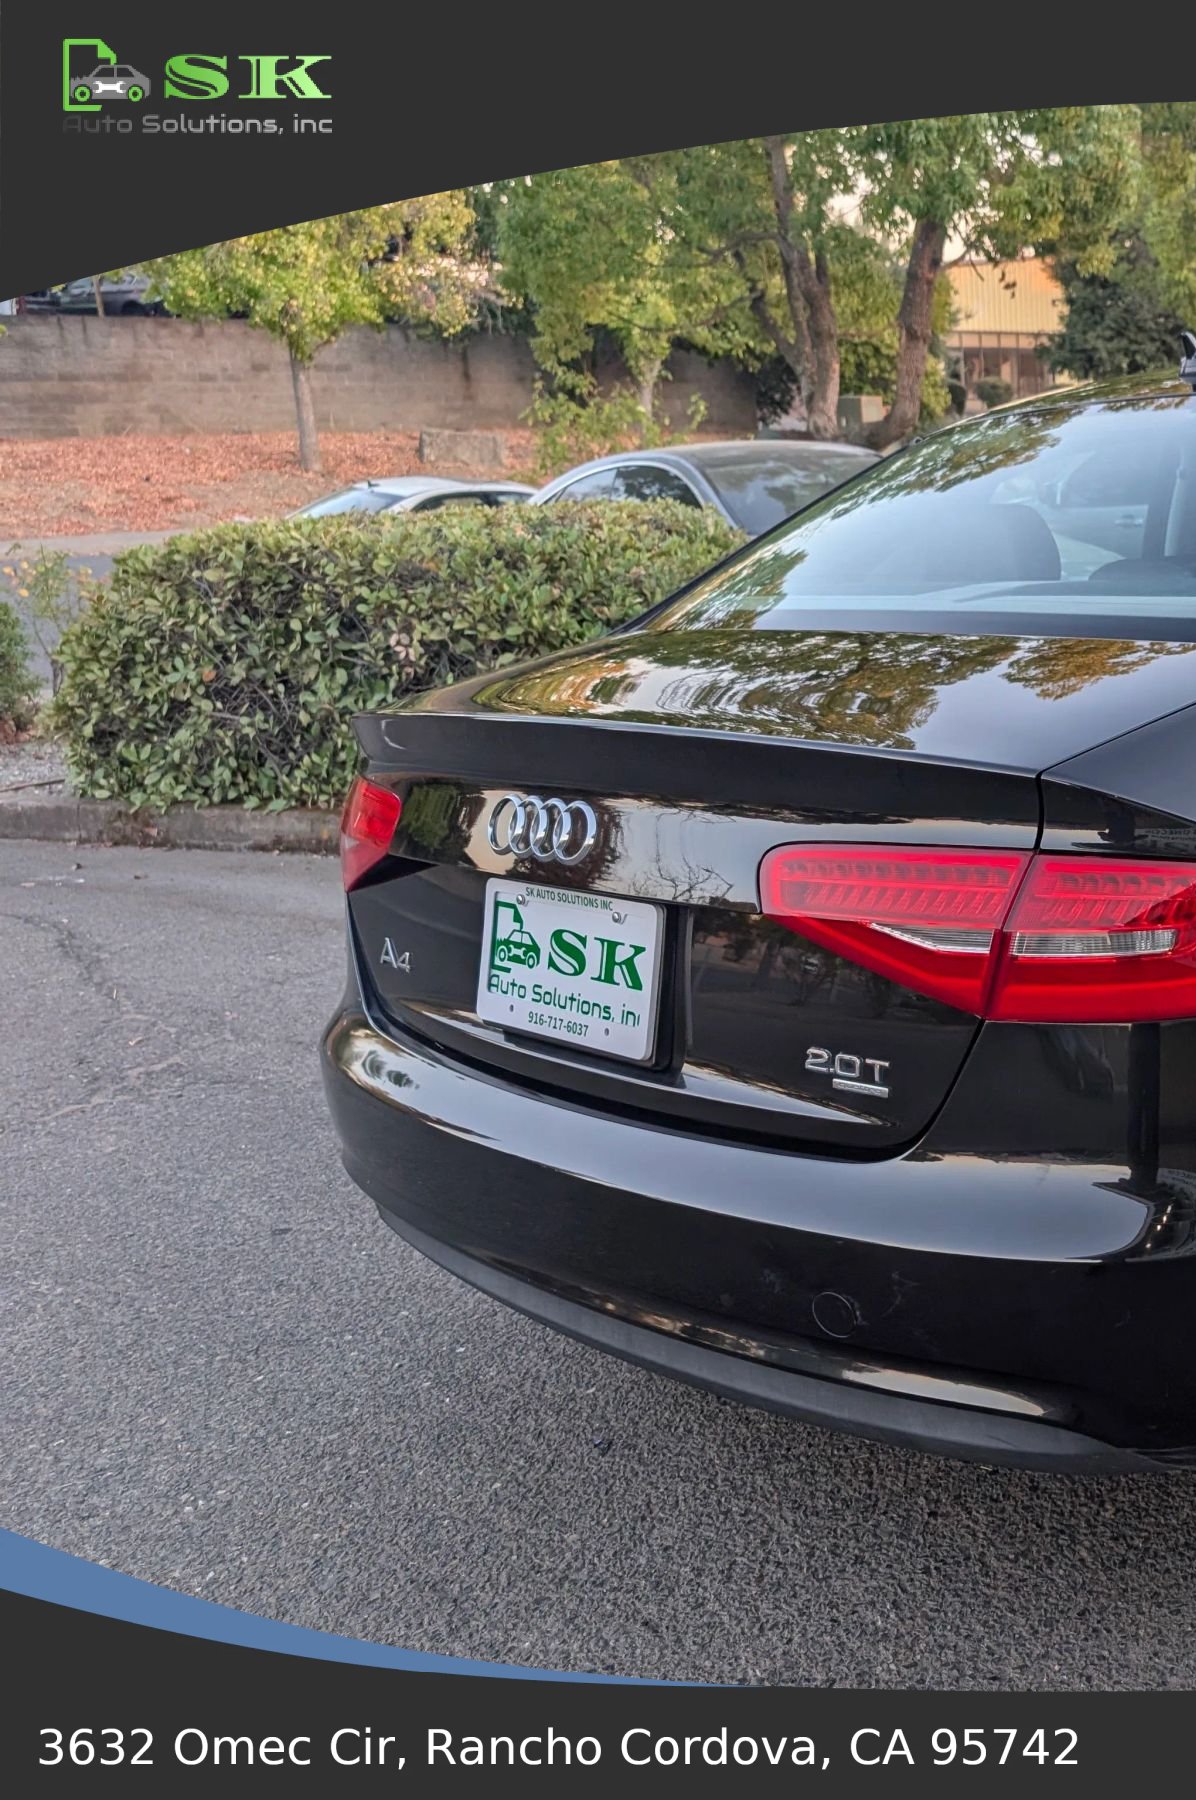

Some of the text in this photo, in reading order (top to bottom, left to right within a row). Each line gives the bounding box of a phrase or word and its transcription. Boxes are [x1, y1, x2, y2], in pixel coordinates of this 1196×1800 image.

[525, 887, 614, 912] SK AUTO SOLUTIONS INC
[380, 937, 411, 973] A4
[547, 928, 647, 992] SK
[488, 974, 527, 999] Auto
[531, 984, 615, 1023] Solutions,
[528, 1011, 589, 1037] 916-717-6037
[804, 1046, 891, 1084] 2.0T
